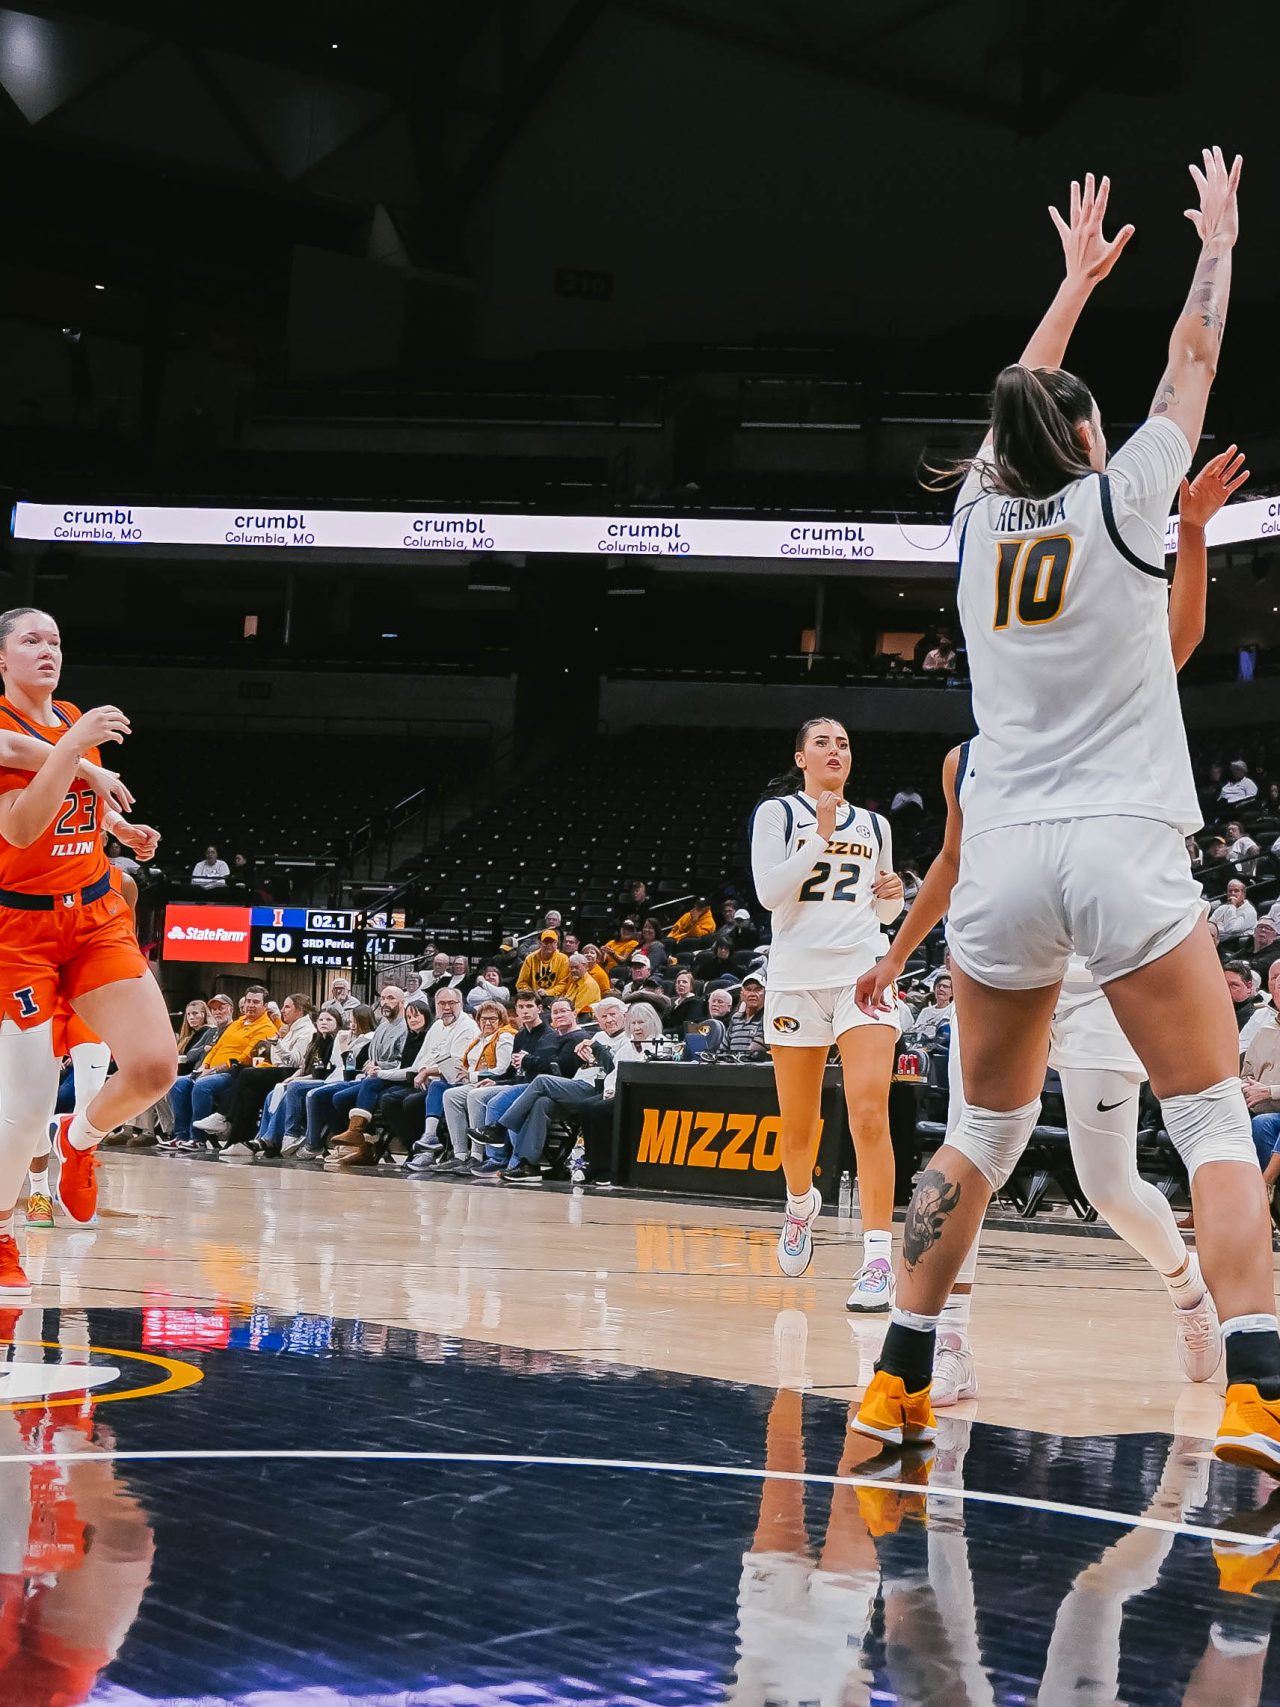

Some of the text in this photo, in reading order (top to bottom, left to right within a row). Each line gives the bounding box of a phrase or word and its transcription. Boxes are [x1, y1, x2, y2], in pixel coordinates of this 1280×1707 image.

[64, 510, 133, 524] crumbl
[235, 515, 305, 529] crumbl
[413, 519, 485, 533] crumbl
[608, 523, 681, 538] crumbl
[53, 527, 141, 540] Columbia, MO
[225, 532, 314, 545] Columbia, MO
[791, 527, 864, 541] crumbl
[403, 536, 494, 550] Columbia, MO
[598, 541, 690, 555] Columbia, MO
[780, 544, 873, 559] Columbia, MO
[993, 534, 1074, 632] 10
[54, 789, 96, 836] 23
[798, 861, 861, 903] 22
[312, 914, 346, 929] 02.1
[260, 933, 292, 953] 50
[302, 938, 324, 949] 3RD
[303, 954, 309, 965] 1
[13, 986, 40, 1018] I
[637, 1108, 824, 1171] MIZZO
